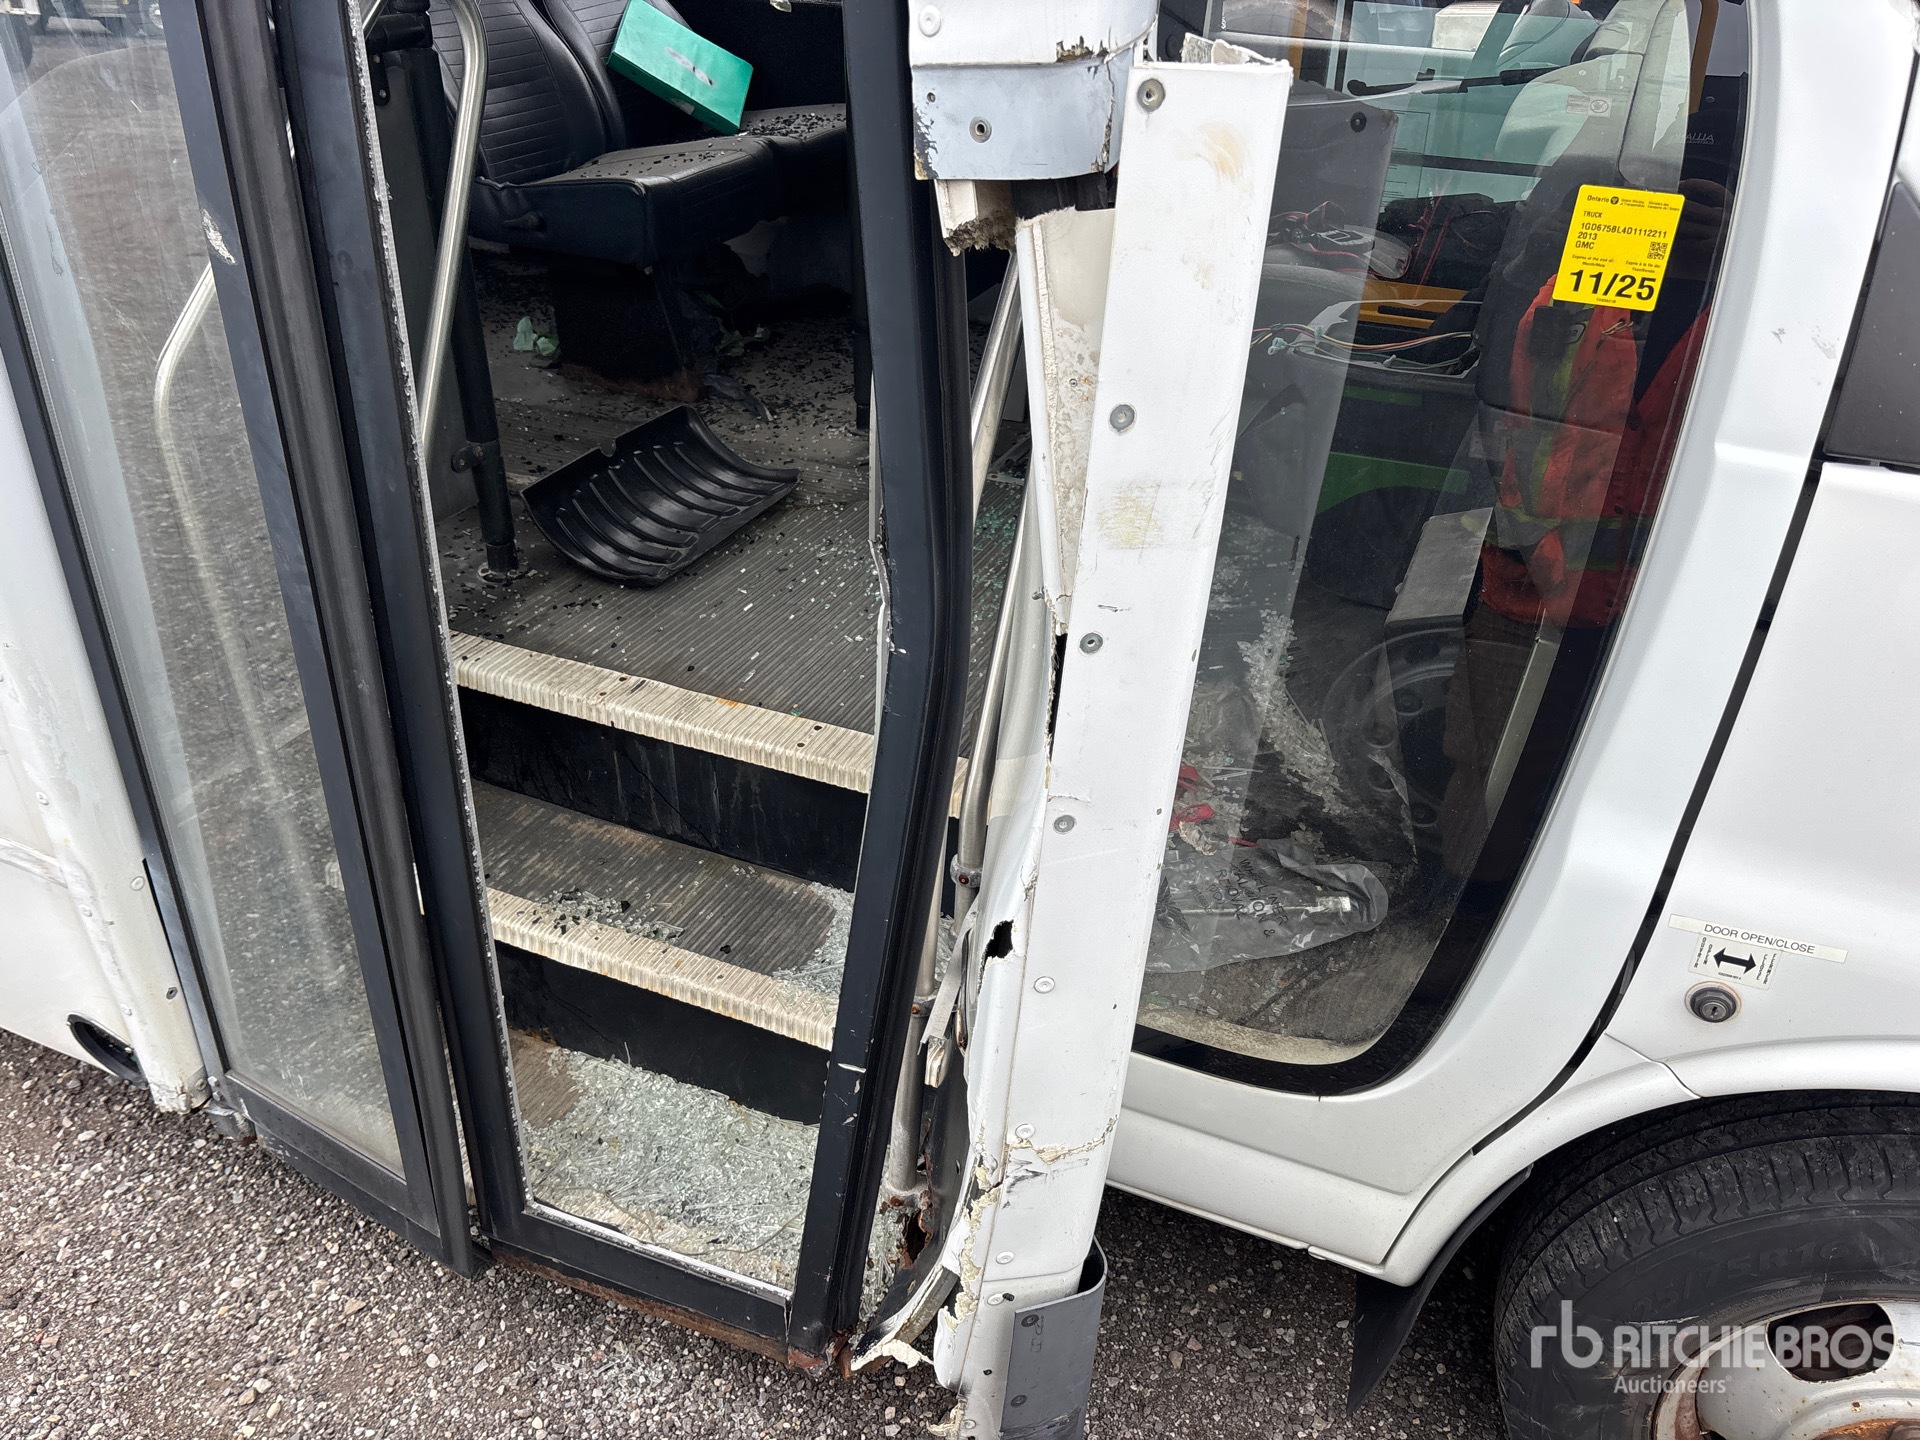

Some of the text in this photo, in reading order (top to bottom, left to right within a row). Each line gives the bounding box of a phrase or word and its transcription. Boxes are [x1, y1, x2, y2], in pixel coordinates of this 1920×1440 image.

[1587, 195, 1610, 203] Ontario
[1577, 231, 1598, 241] 2013
[1575, 240, 1595, 250] GMC
[1570, 269, 1657, 301] 11/25
[1263, 928, 1276, 939] &
[1704, 924, 1815, 954] DOOR OPEN/CLOSE
